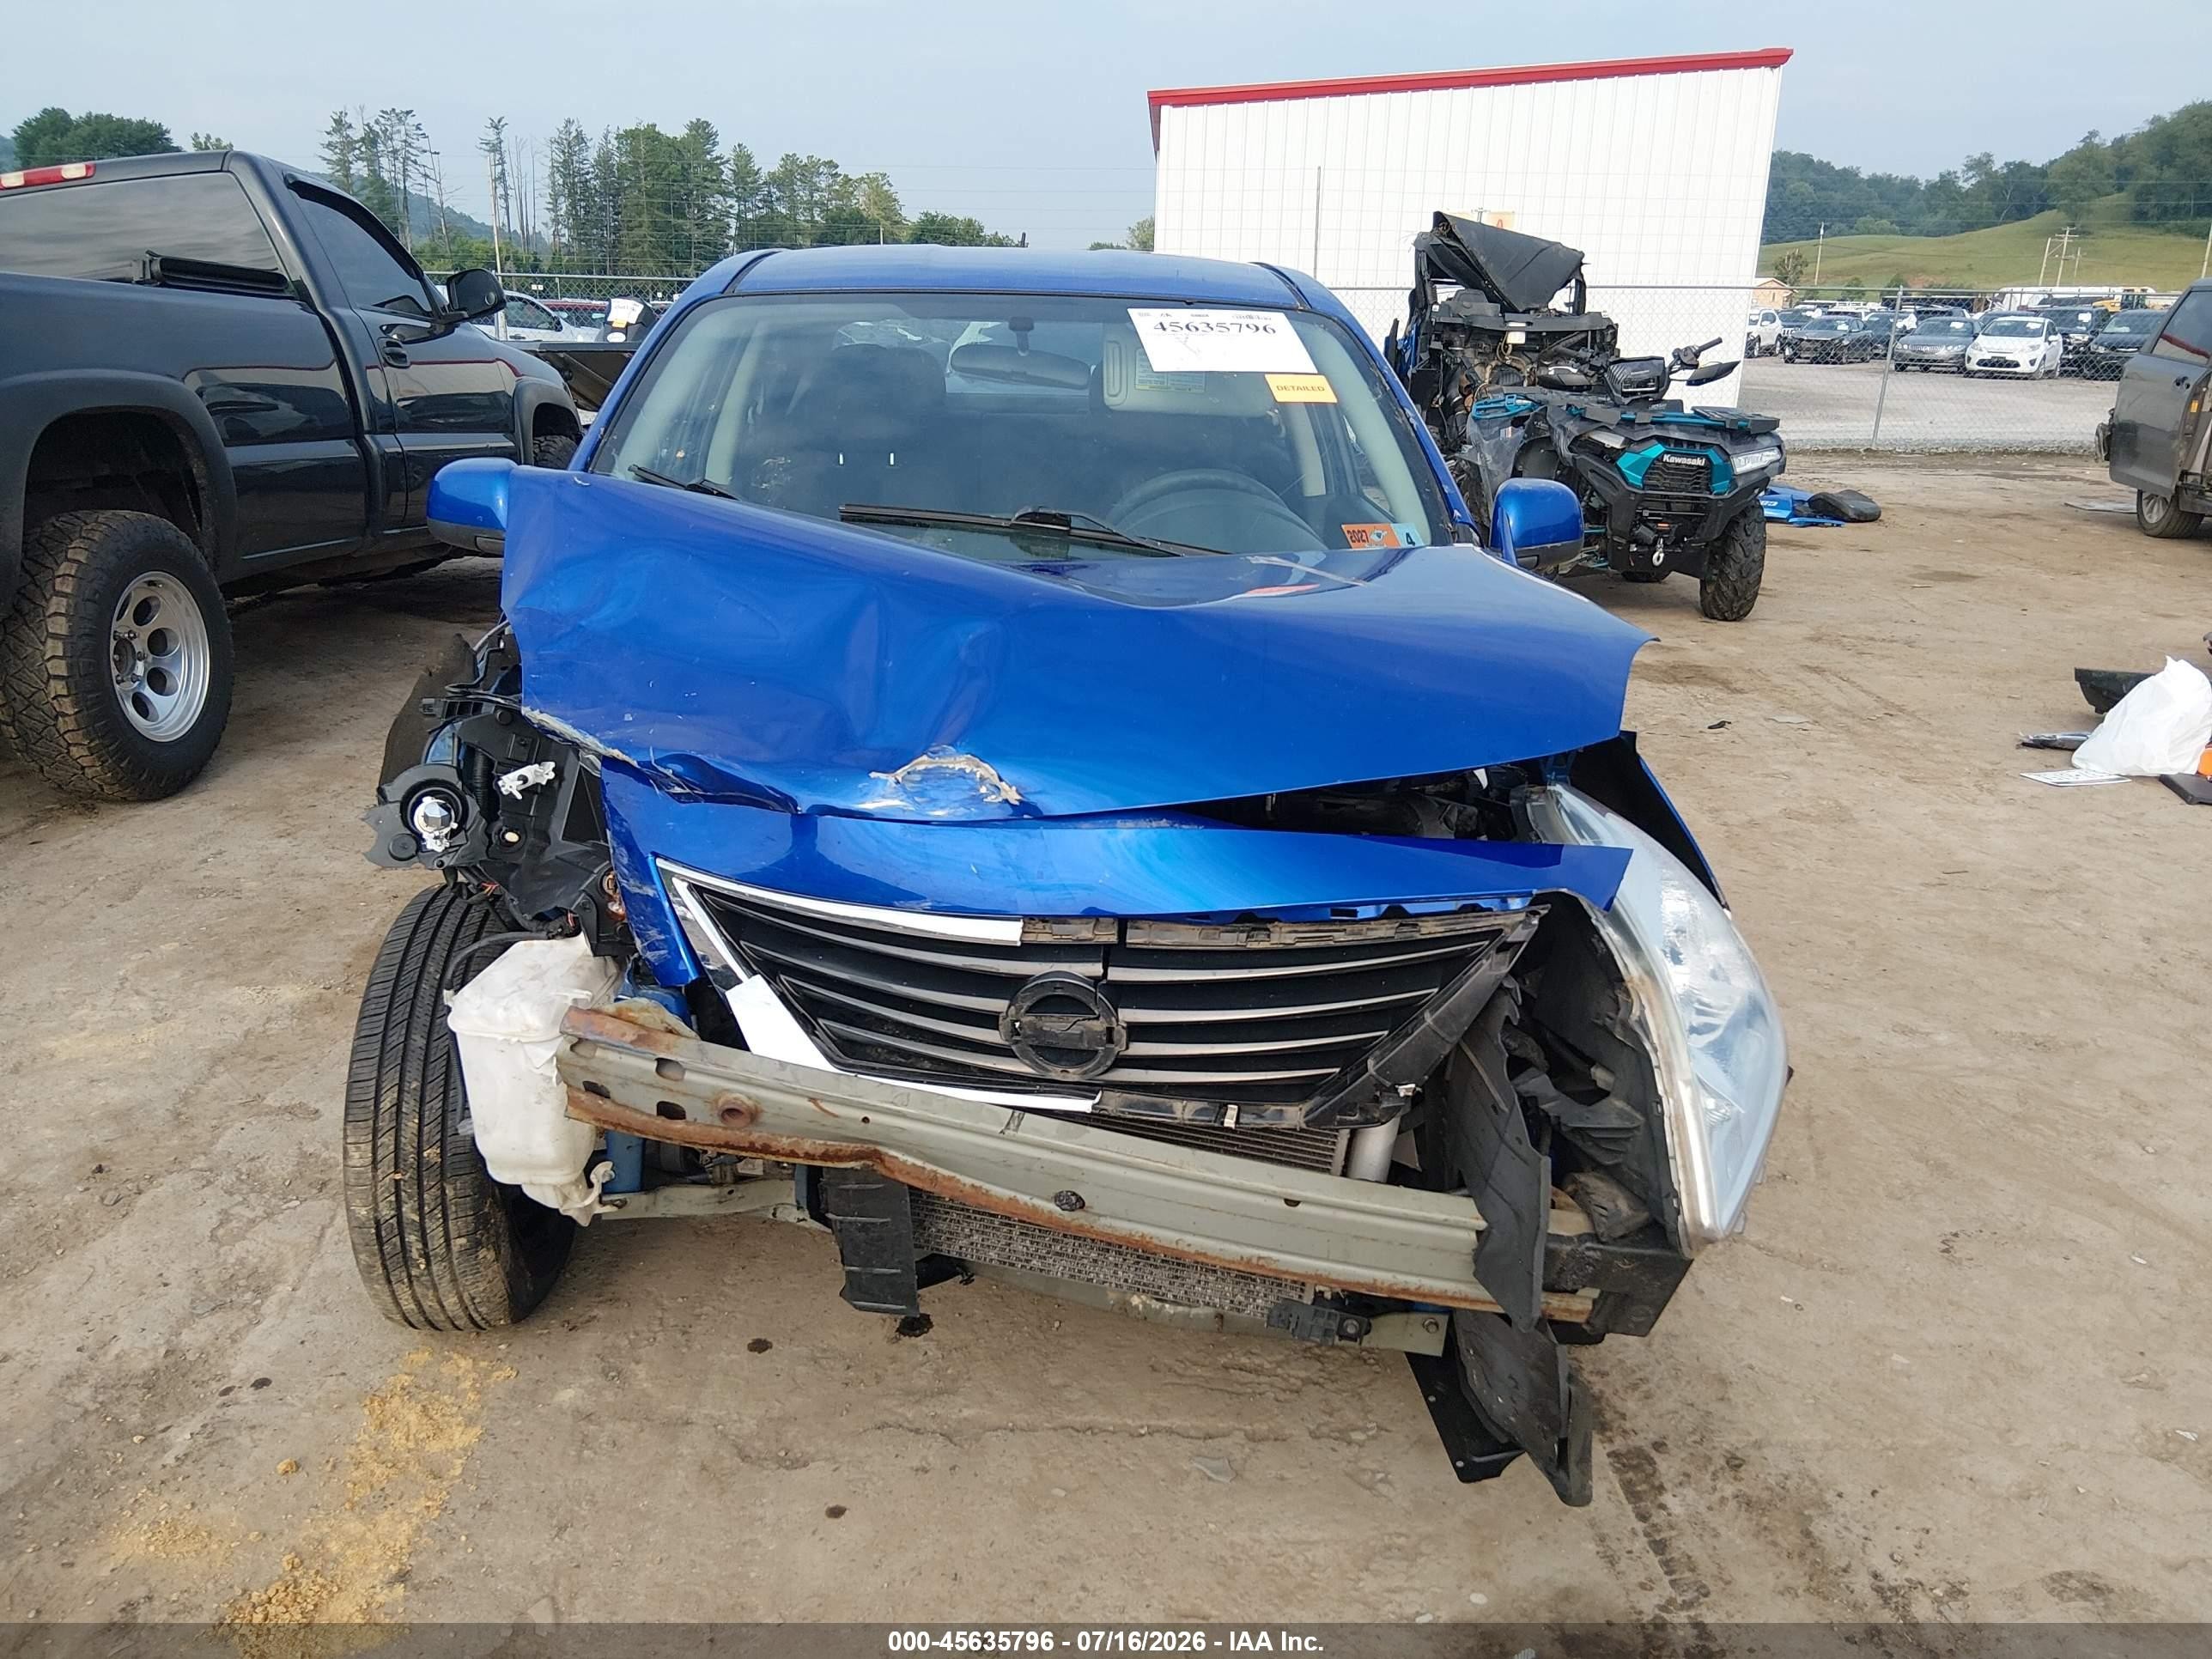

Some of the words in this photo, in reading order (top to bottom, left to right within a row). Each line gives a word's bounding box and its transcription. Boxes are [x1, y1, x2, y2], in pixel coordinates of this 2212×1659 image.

[1153, 321, 1277, 335] 45635796
[1662, 453, 1706, 466] Kawasaki
[1346, 529, 1370, 544] 2027
[1405, 532, 1416, 547] 4
